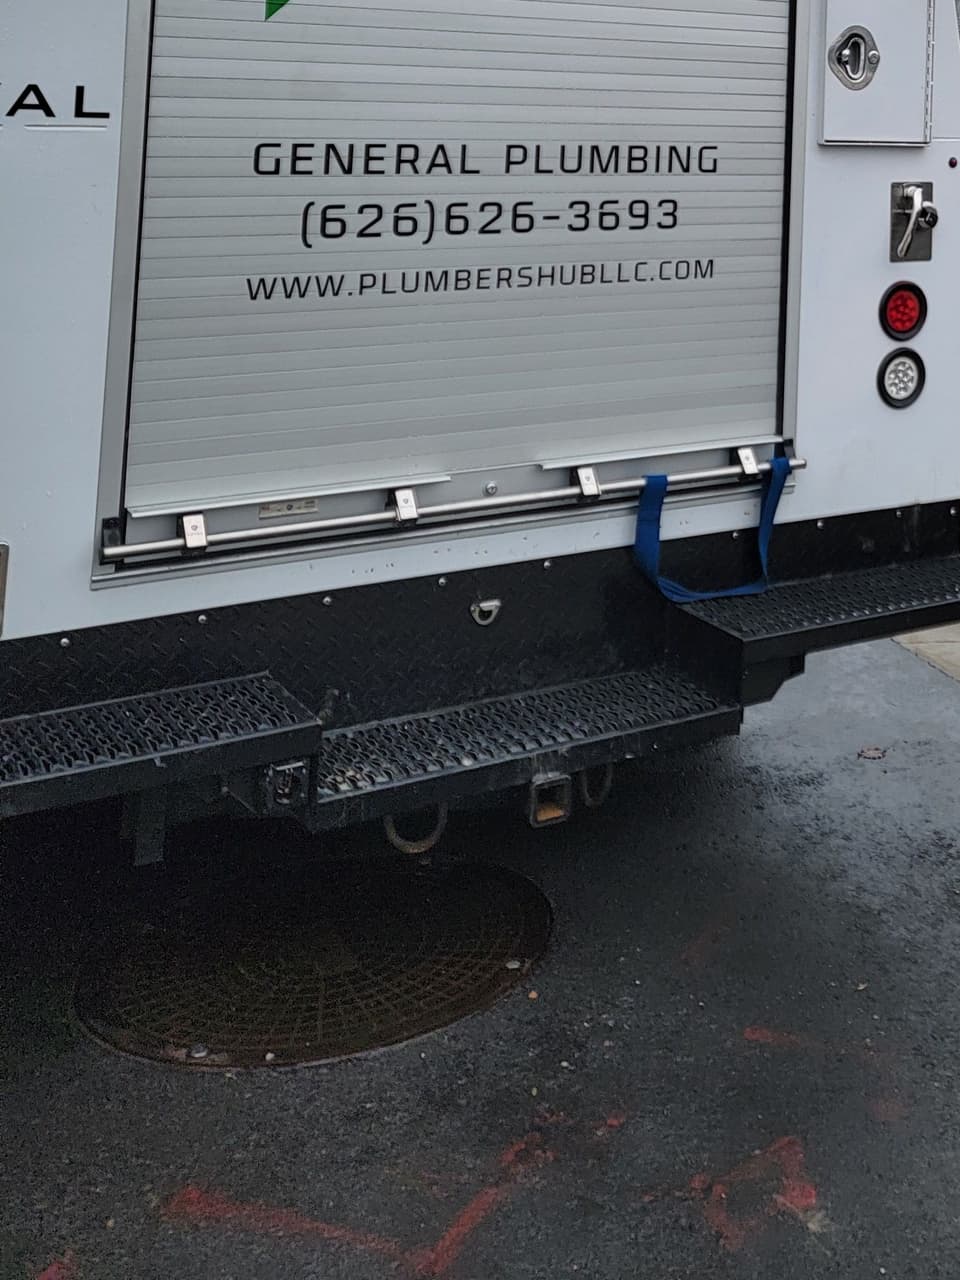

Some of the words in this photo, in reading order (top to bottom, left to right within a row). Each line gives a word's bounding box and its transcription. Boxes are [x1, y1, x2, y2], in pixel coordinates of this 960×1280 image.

[0, 82, 111, 119] AL
[253, 142, 481, 176] GENERAL
[504, 144, 718, 175] PLUMBING
[301, 199, 678, 249] (626)626-3693
[245, 258, 714, 302] WWW.PLUMBERSHUBLLC.COM
